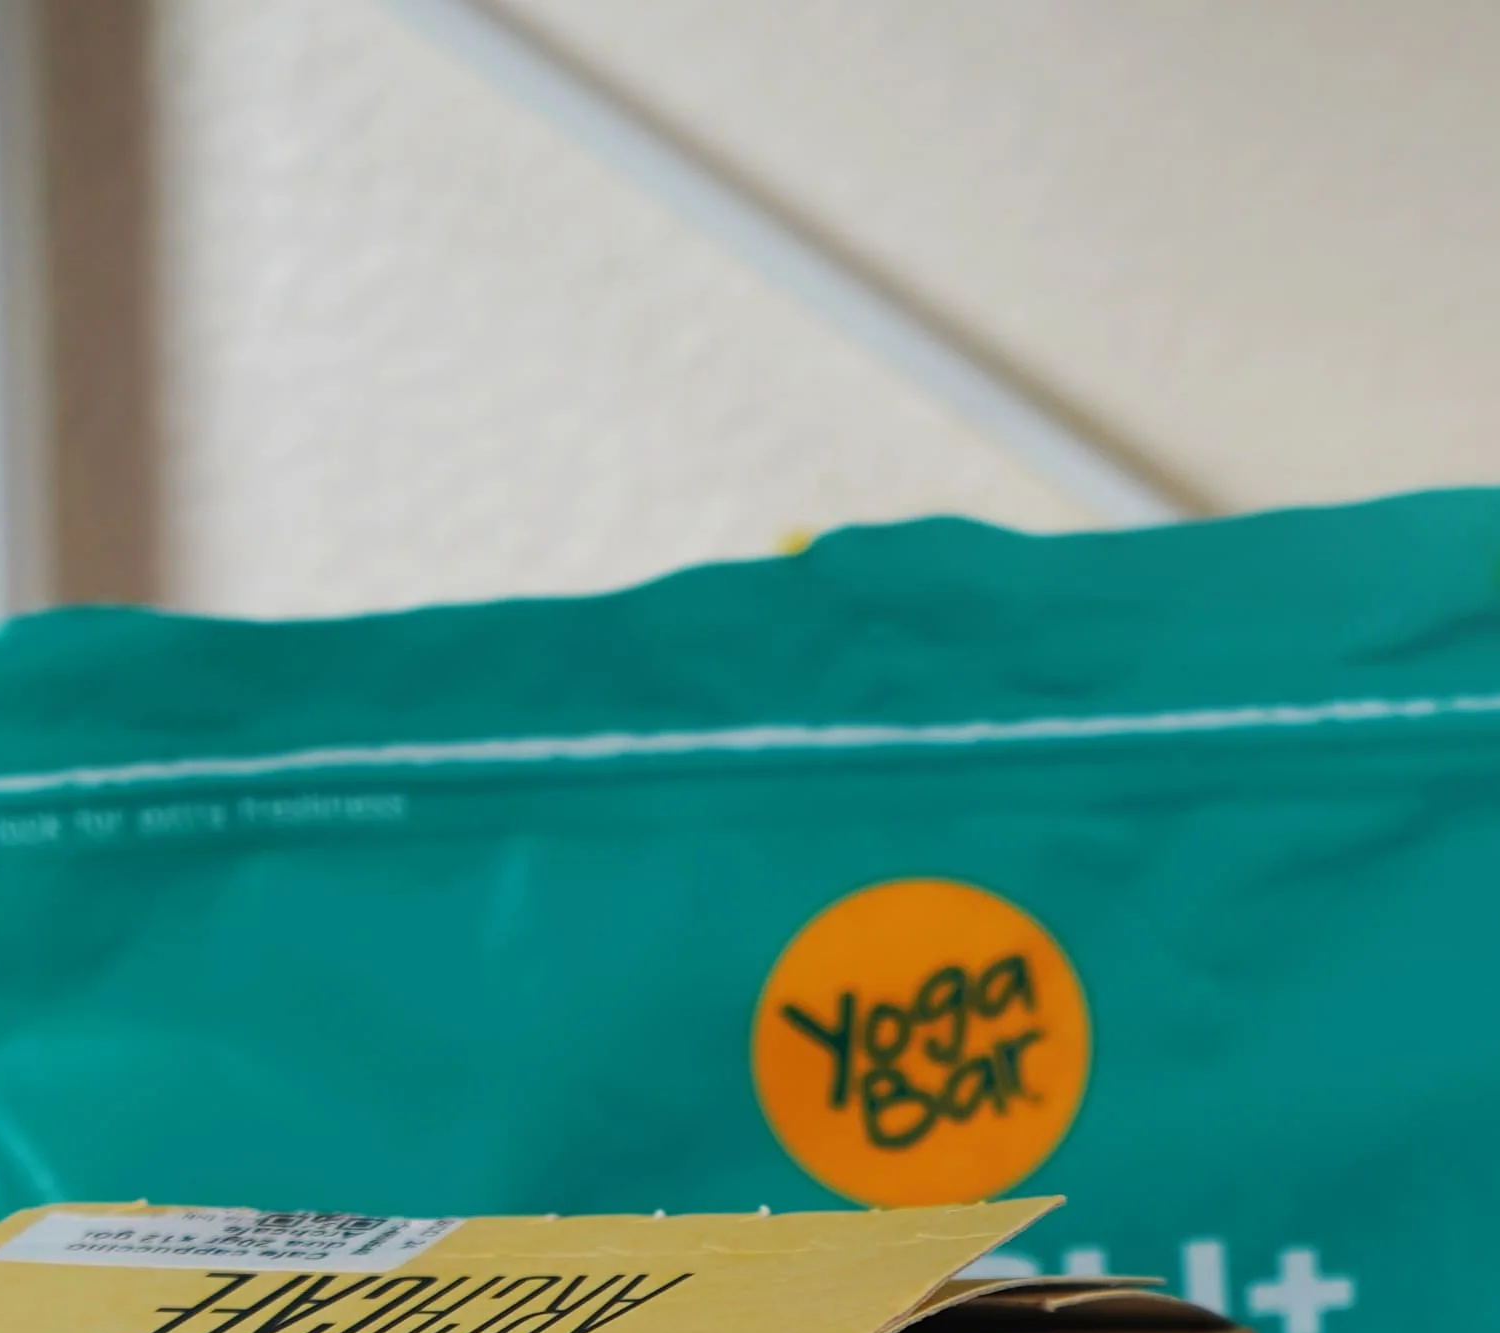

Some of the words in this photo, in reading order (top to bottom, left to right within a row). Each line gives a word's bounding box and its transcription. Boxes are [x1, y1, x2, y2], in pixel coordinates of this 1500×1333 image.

[779, 954, 1040, 1111] Yoga
[861, 1028, 1045, 1152] Bar
[66, 1243, 249, 1258] cappuccino
